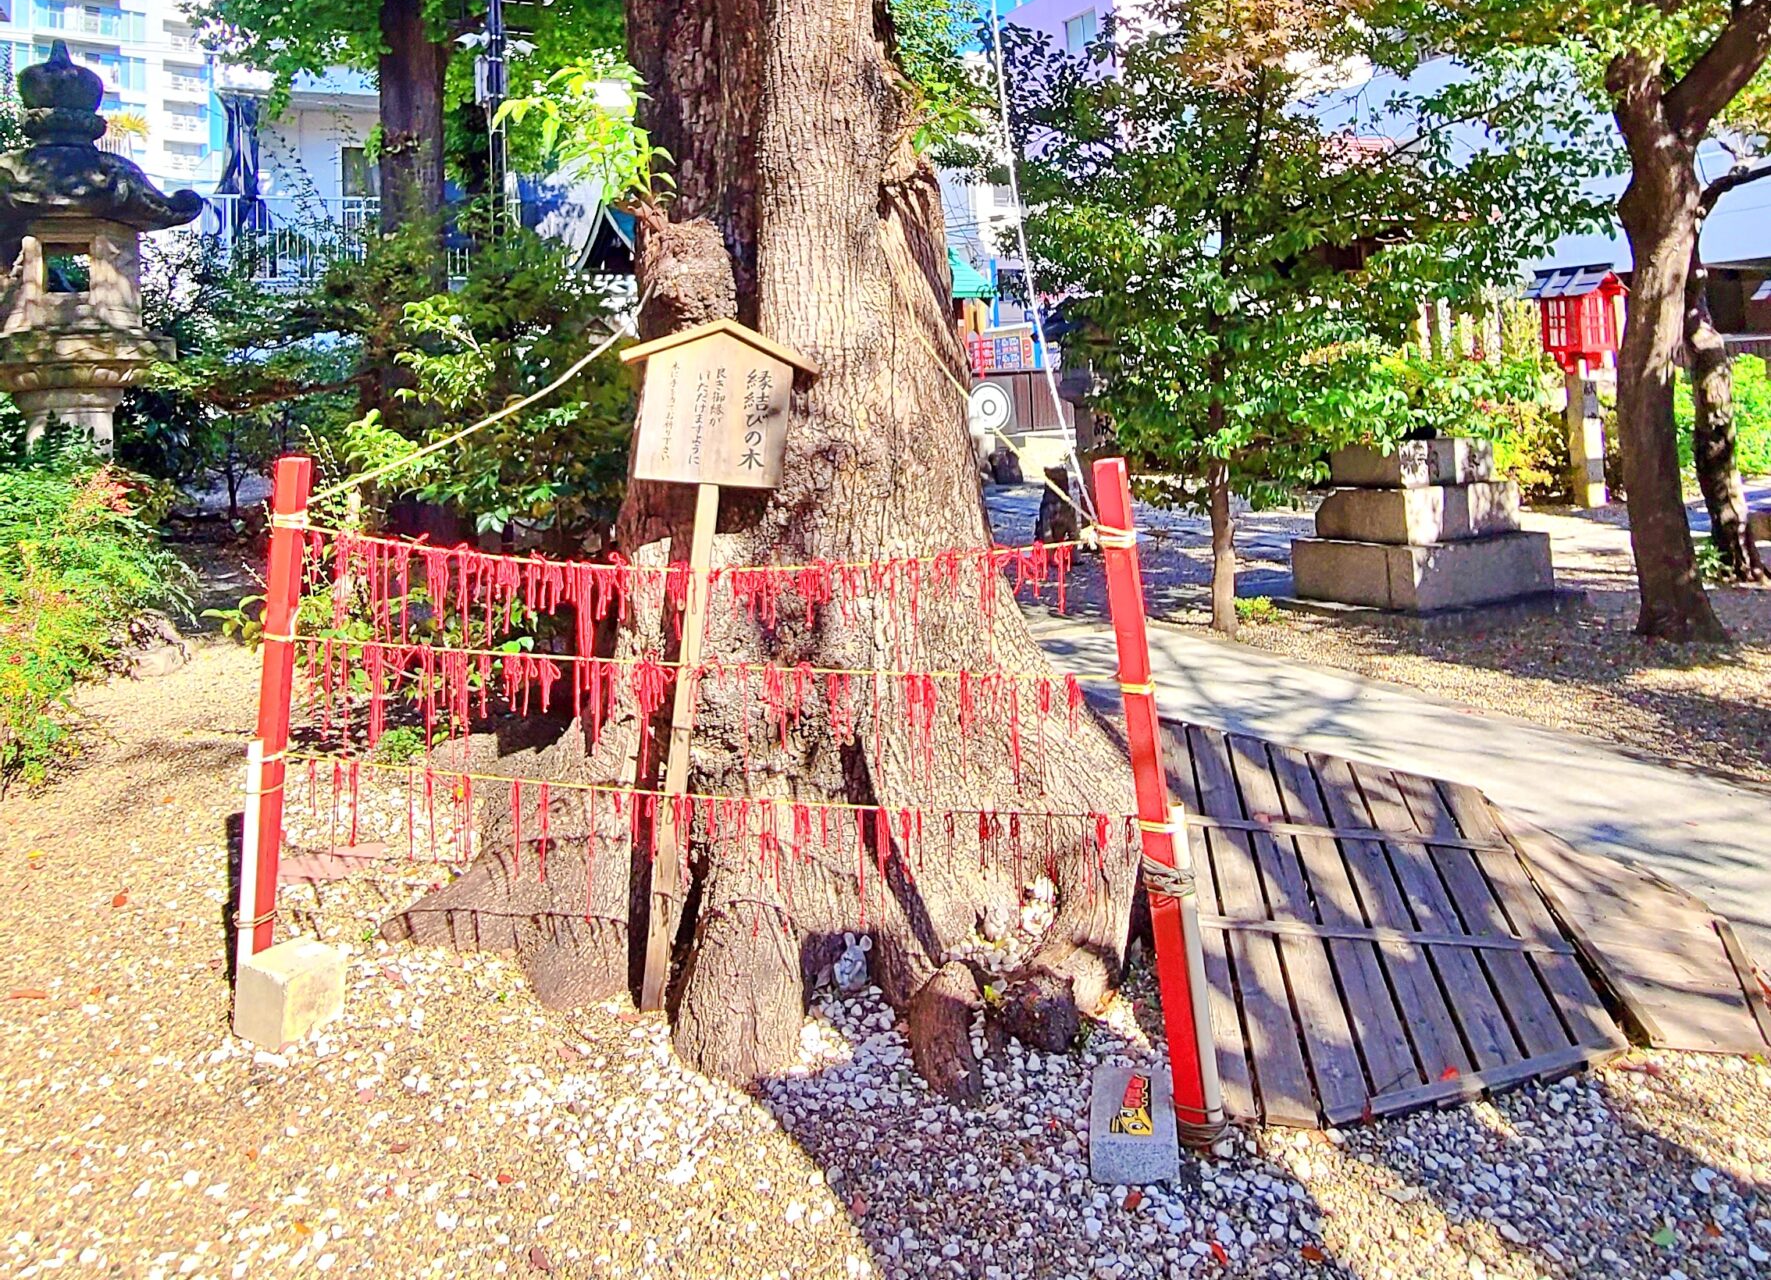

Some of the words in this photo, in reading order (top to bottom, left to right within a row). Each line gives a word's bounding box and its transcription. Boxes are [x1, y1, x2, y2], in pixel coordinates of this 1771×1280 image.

[688, 370, 711, 465] いただけますように
[708, 365, 727, 427] 良き御縁が
[738, 368, 774, 470] 縁結びの木
